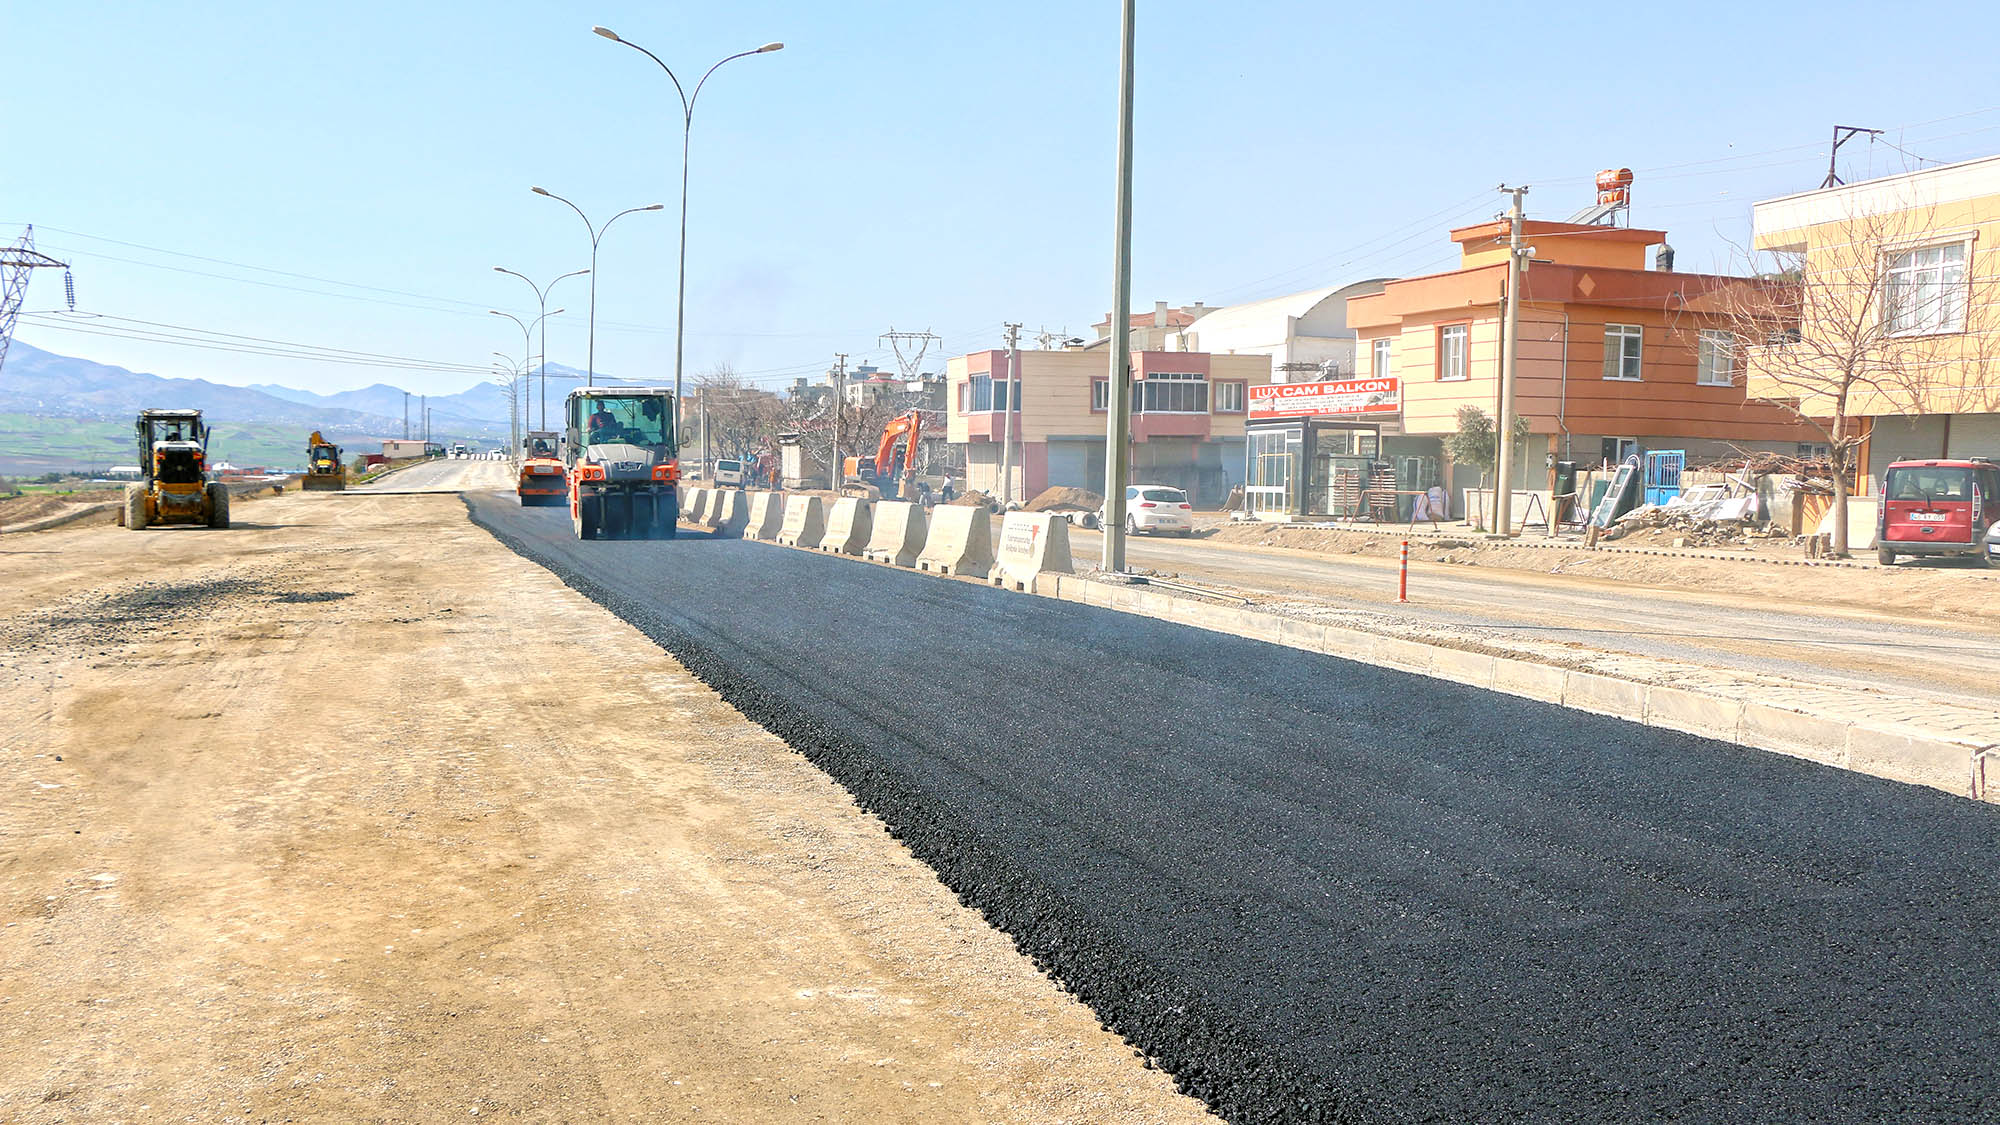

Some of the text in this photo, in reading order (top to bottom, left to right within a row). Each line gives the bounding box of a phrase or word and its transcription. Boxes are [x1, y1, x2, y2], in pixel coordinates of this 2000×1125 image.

[1256, 387, 1280, 399] LUX
[1283, 386, 1319, 397] CAM
[1323, 381, 1390, 394] BALKON
